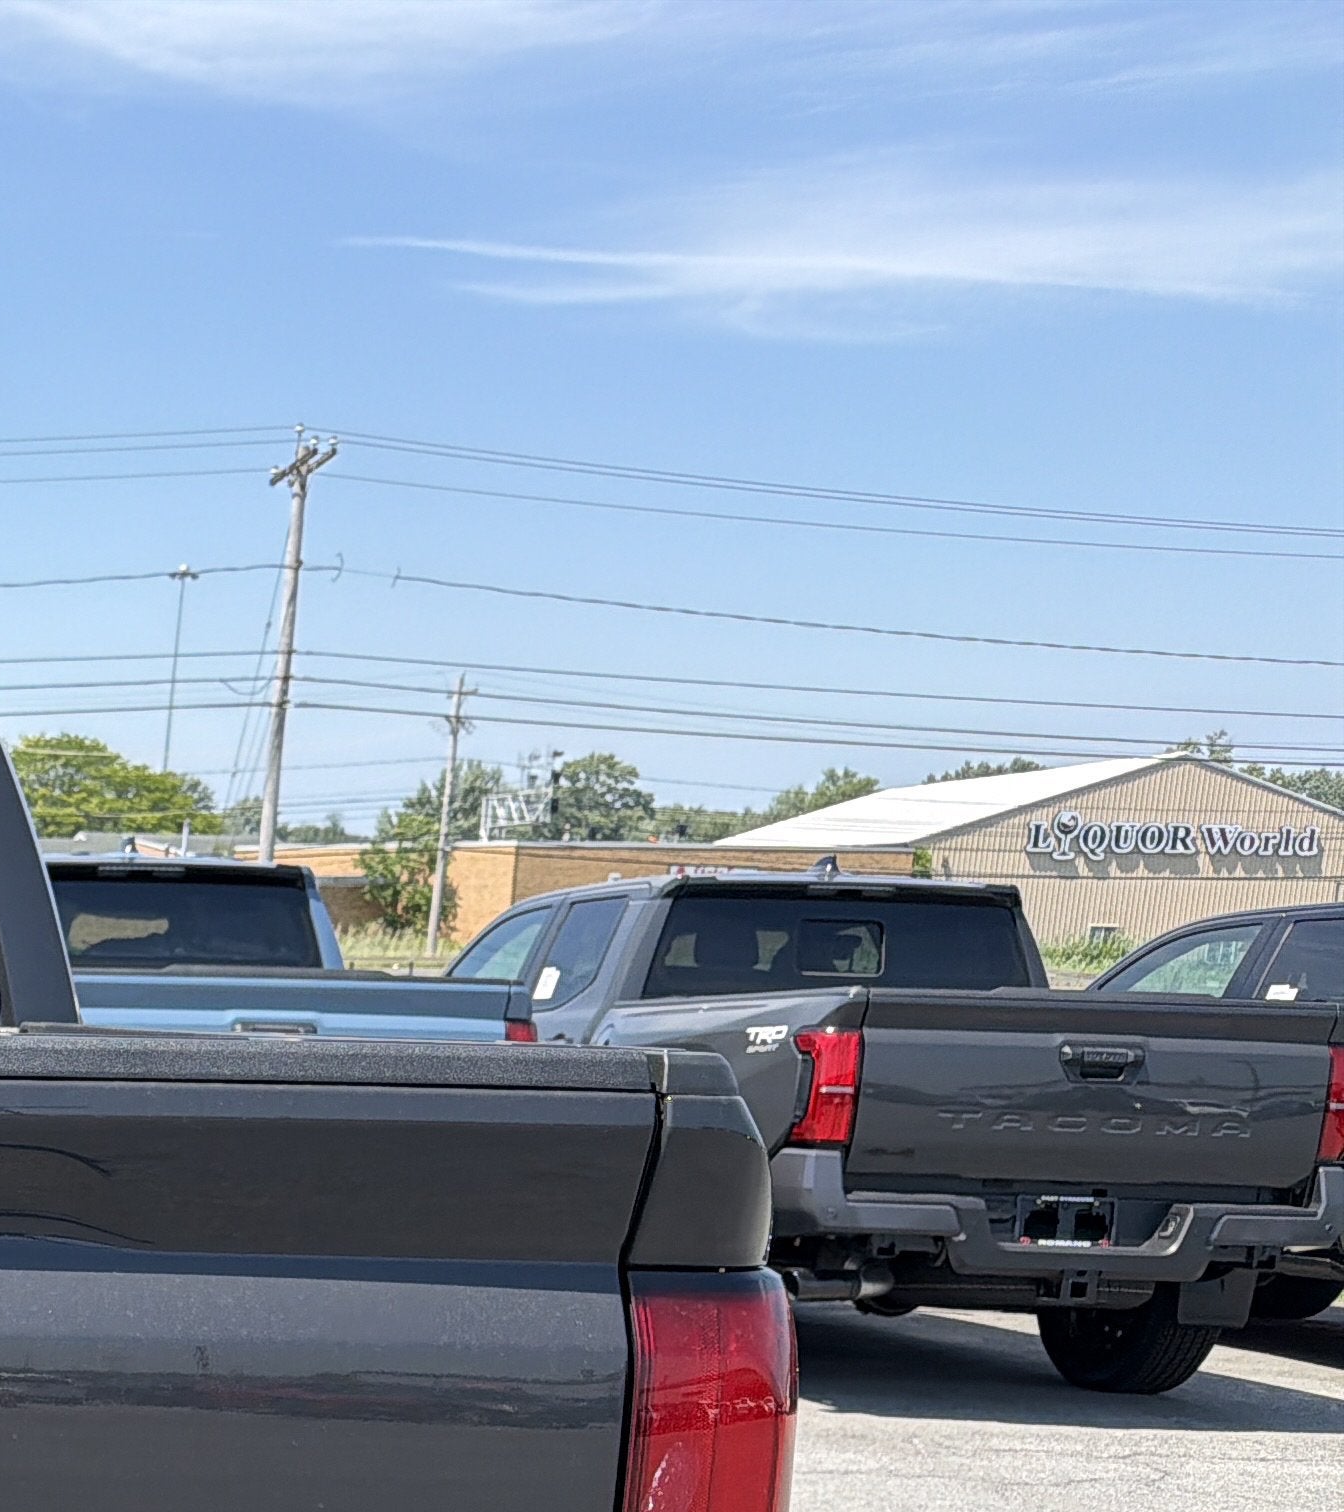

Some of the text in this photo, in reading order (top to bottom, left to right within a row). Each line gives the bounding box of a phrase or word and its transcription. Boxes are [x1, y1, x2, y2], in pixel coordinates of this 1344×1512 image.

[1201, 824, 1321, 857] World
[745, 1024, 789, 1045] TRD
[937, 1109, 1251, 1138] TACOMA
